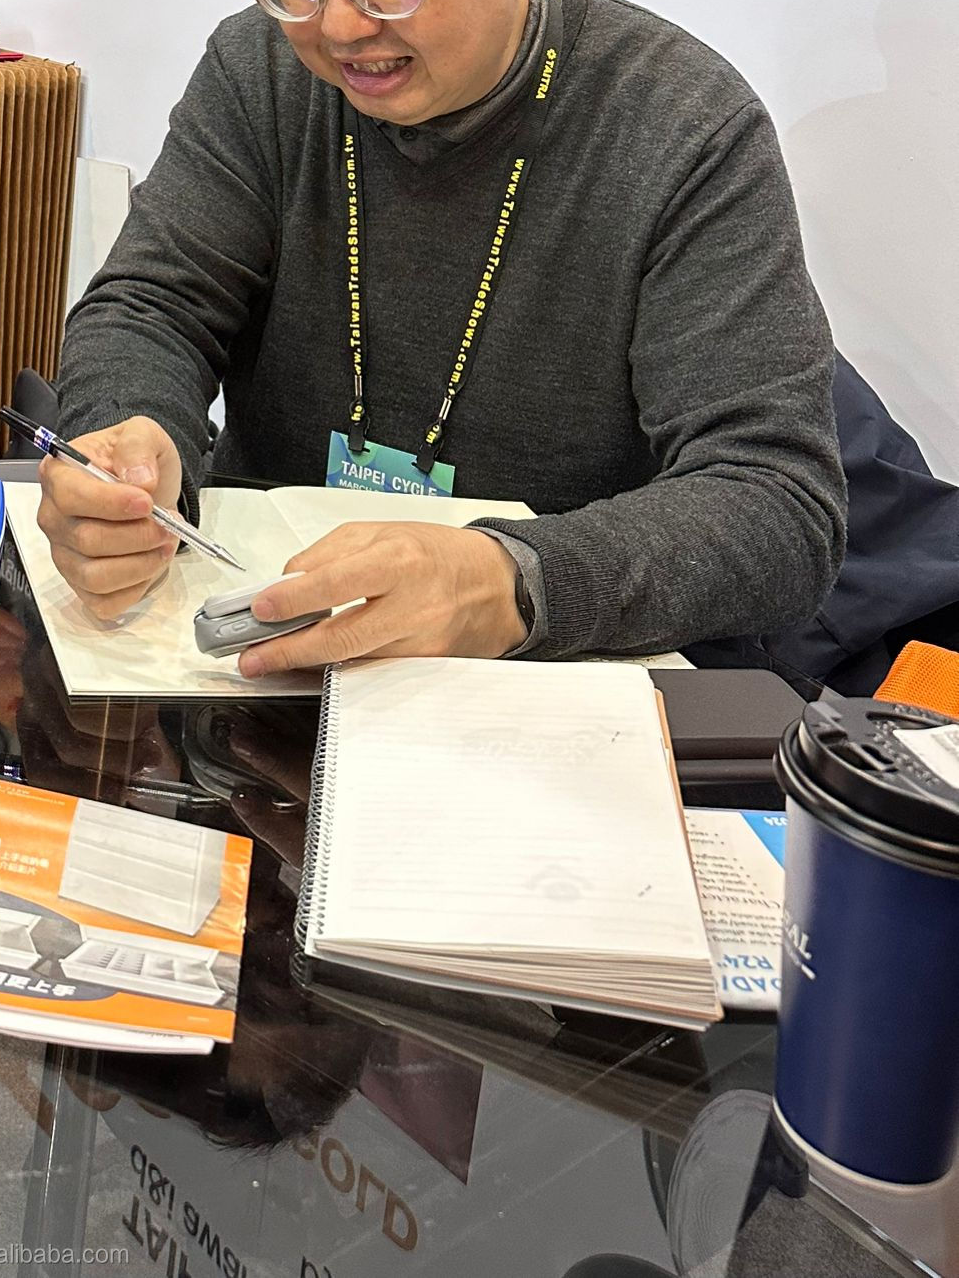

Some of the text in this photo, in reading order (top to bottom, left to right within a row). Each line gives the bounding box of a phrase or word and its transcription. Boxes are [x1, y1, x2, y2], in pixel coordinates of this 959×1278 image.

[535, 59, 557, 99] TAITRA
[341, 460, 437, 496] TAIPEI CYCLE
